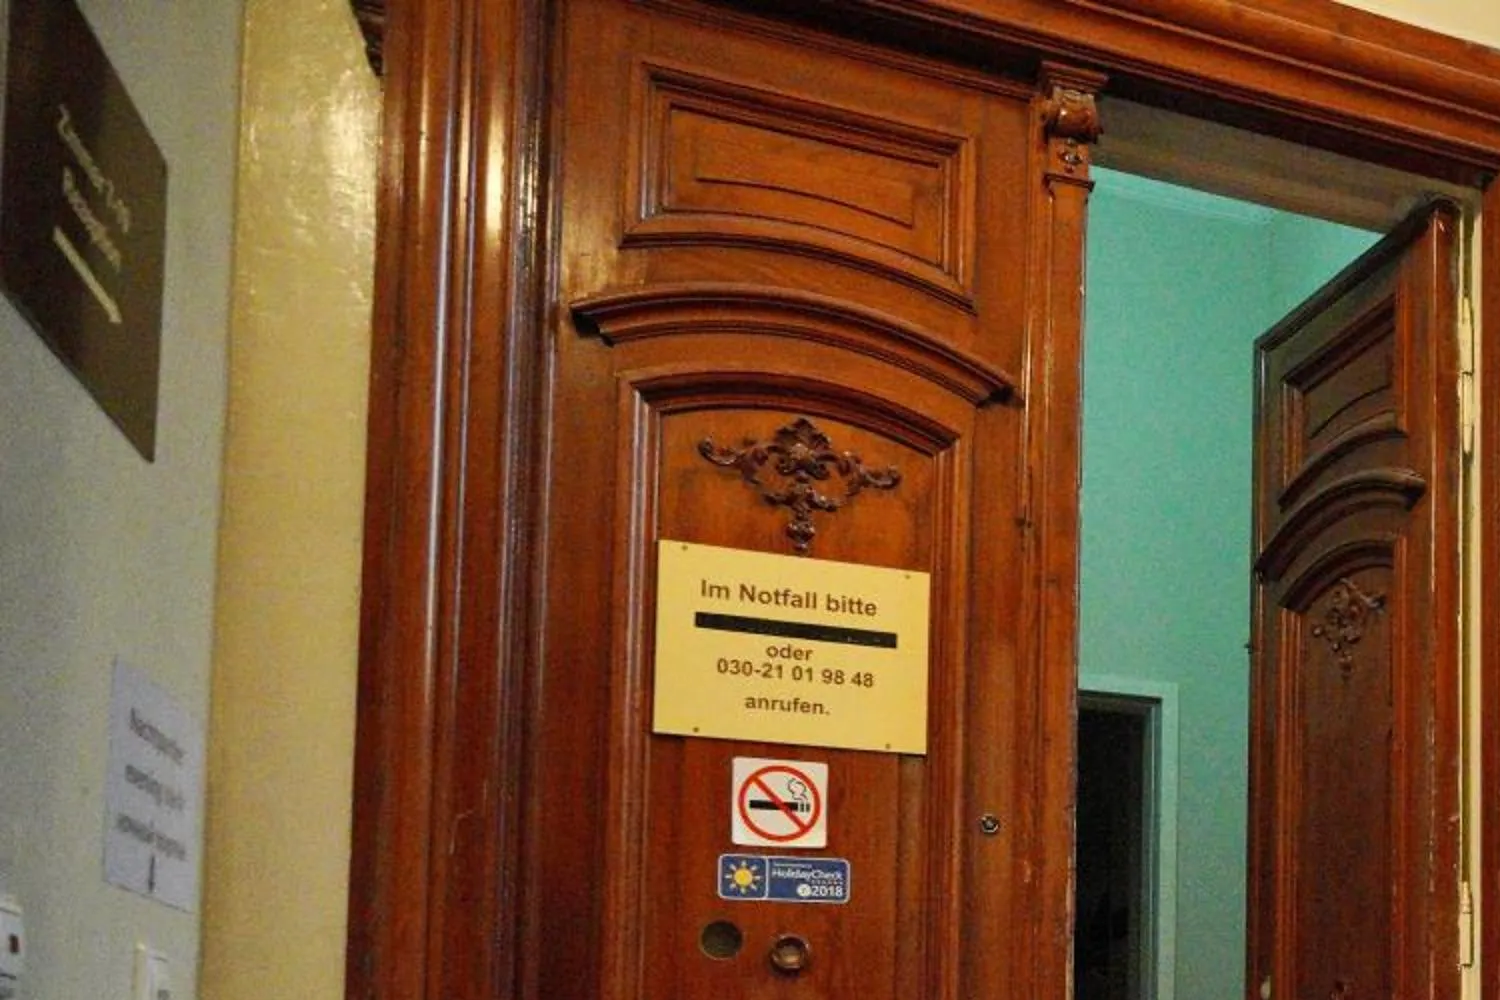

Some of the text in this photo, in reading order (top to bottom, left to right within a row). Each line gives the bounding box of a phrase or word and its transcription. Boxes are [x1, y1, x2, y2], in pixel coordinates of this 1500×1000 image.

[701, 578, 877, 617] Im Notfall bitte
[766, 643, 813, 661] oder
[716, 657, 874, 688] 030-21 01 98 48
[744, 694, 830, 715] anrufen.
[811, 885, 843, 897] 2018
